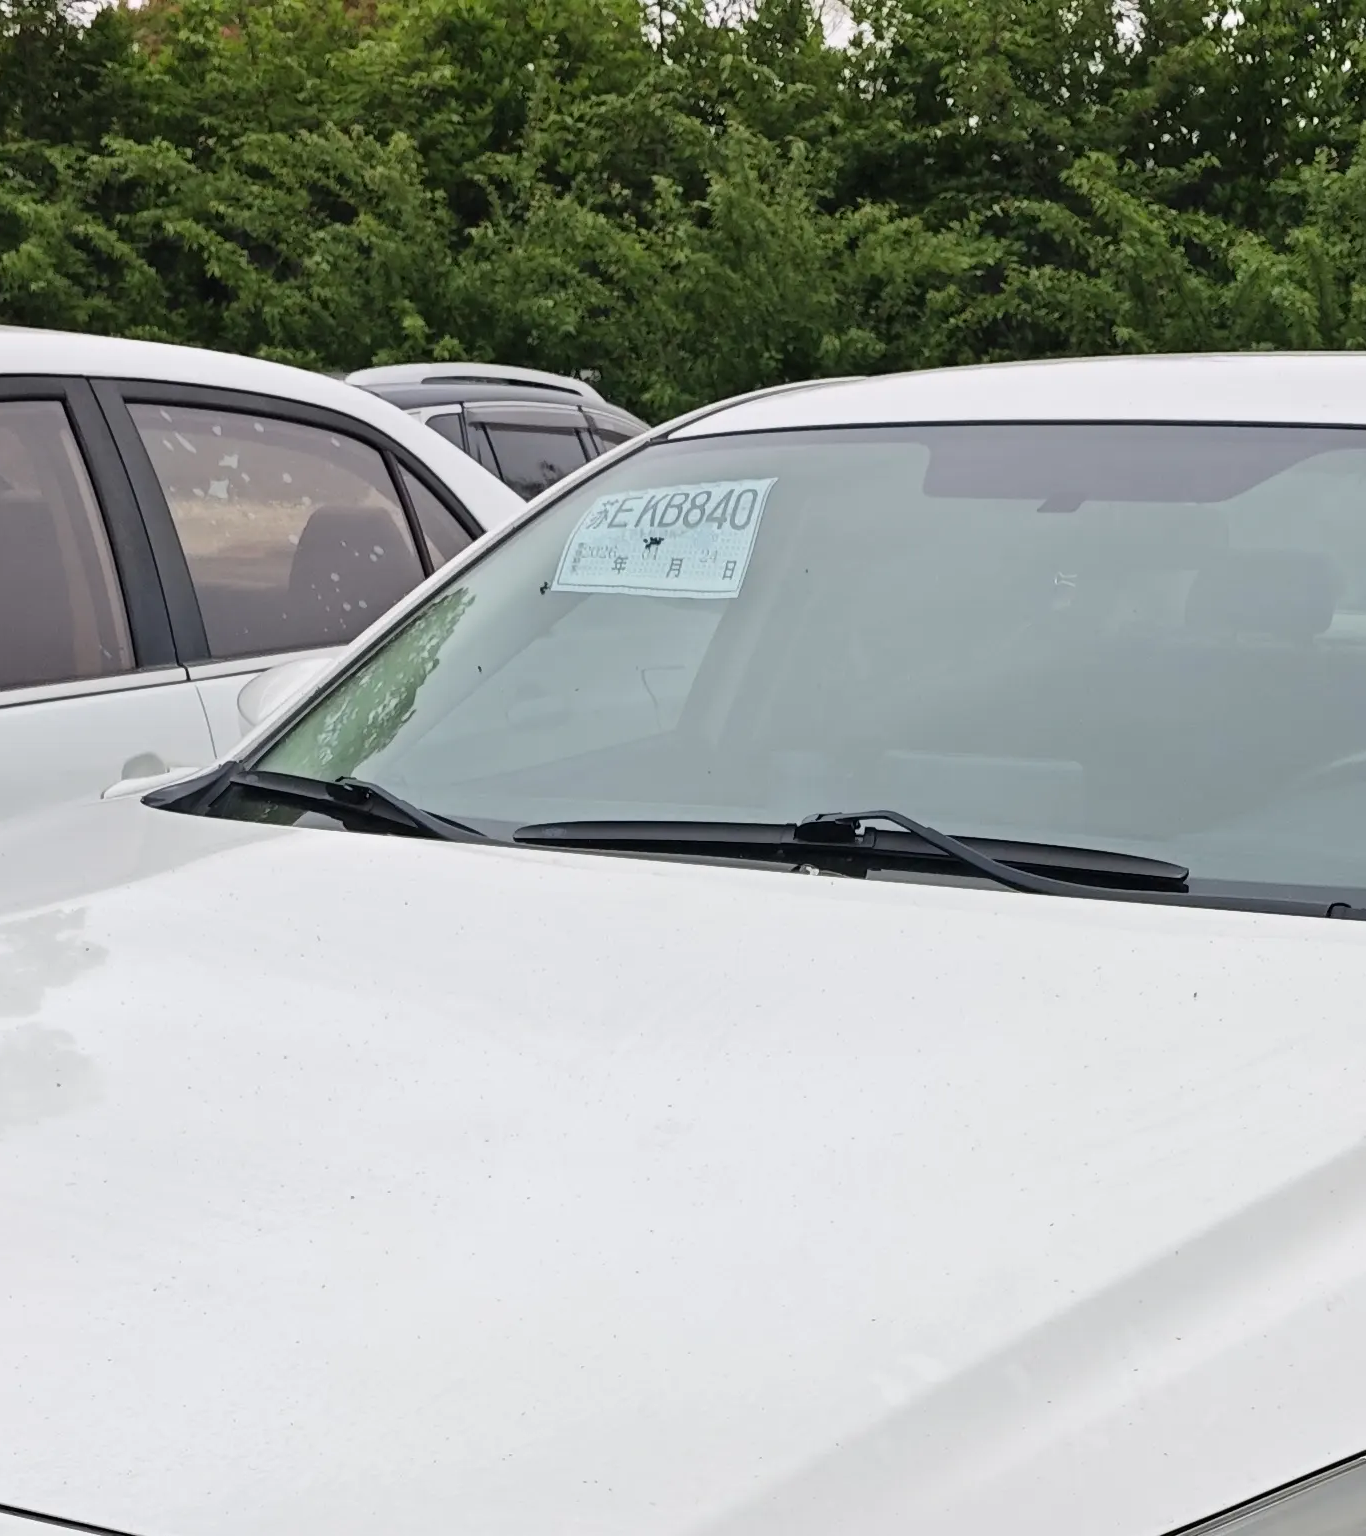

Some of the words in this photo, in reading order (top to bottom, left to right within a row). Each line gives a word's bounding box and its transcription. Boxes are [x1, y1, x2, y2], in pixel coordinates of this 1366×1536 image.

[612, 556, 628, 574] 年
[666, 557, 683, 578] 月
[722, 560, 737, 580] 日
